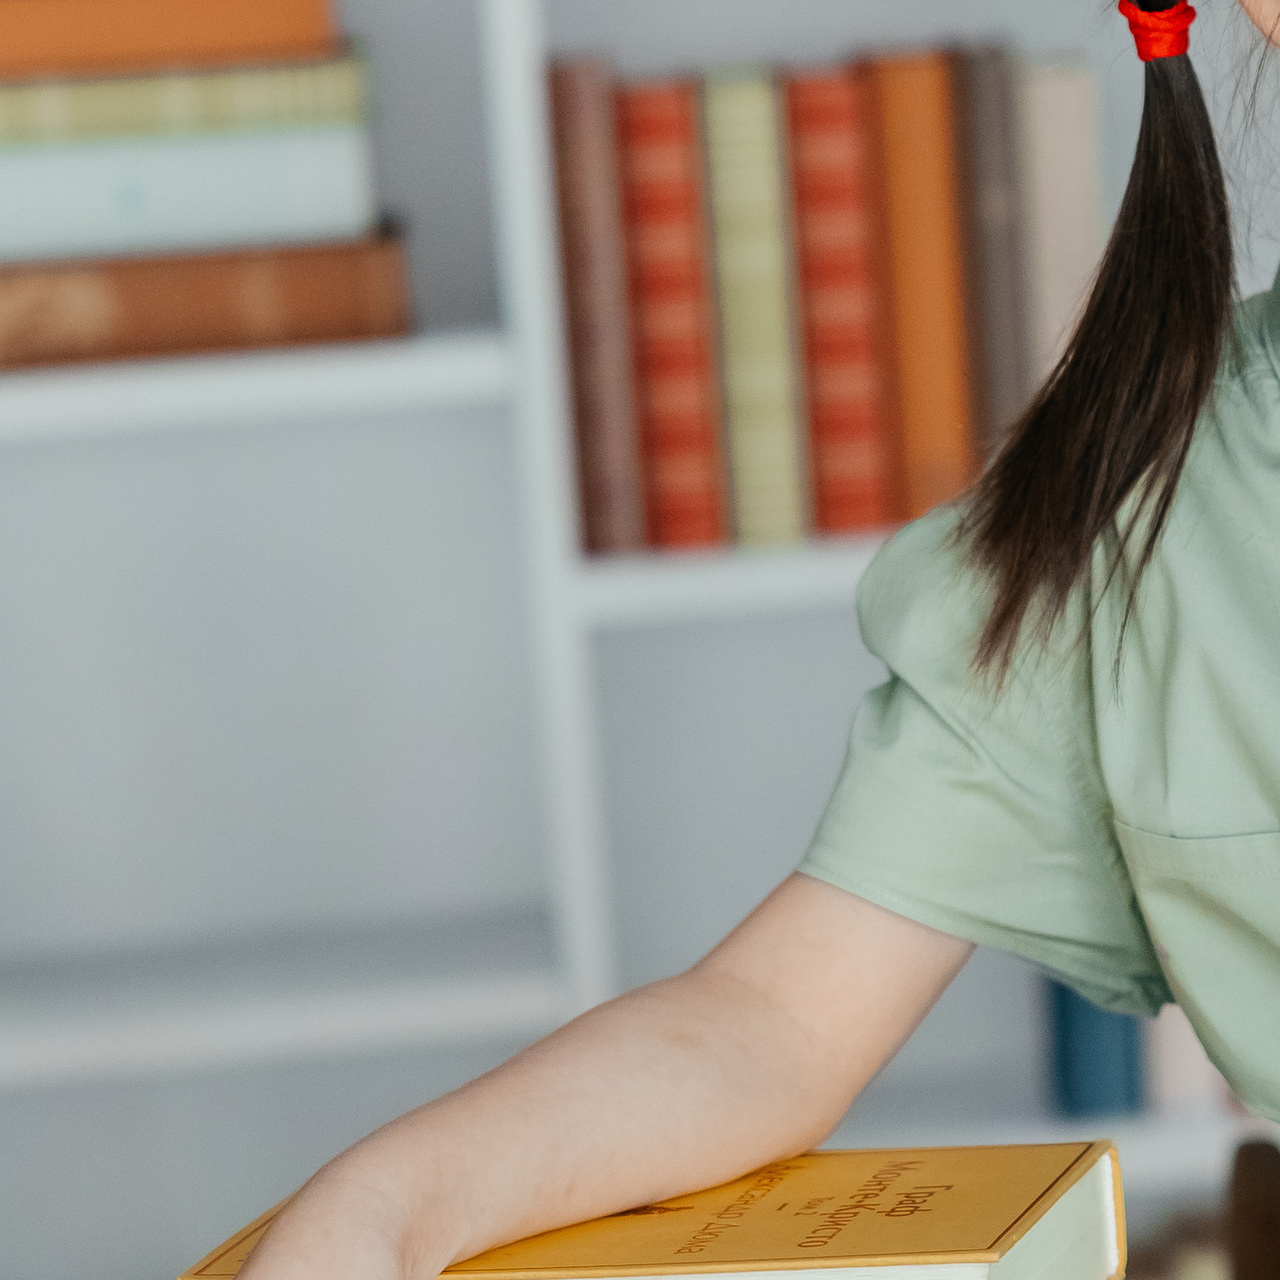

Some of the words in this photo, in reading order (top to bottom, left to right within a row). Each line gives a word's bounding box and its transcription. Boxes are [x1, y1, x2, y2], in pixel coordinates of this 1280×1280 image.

[797, 1160, 925, 1249] Монте-Кристо
[876, 1183, 954, 1218] Граф
[673, 1222, 740, 1255] Дюма
